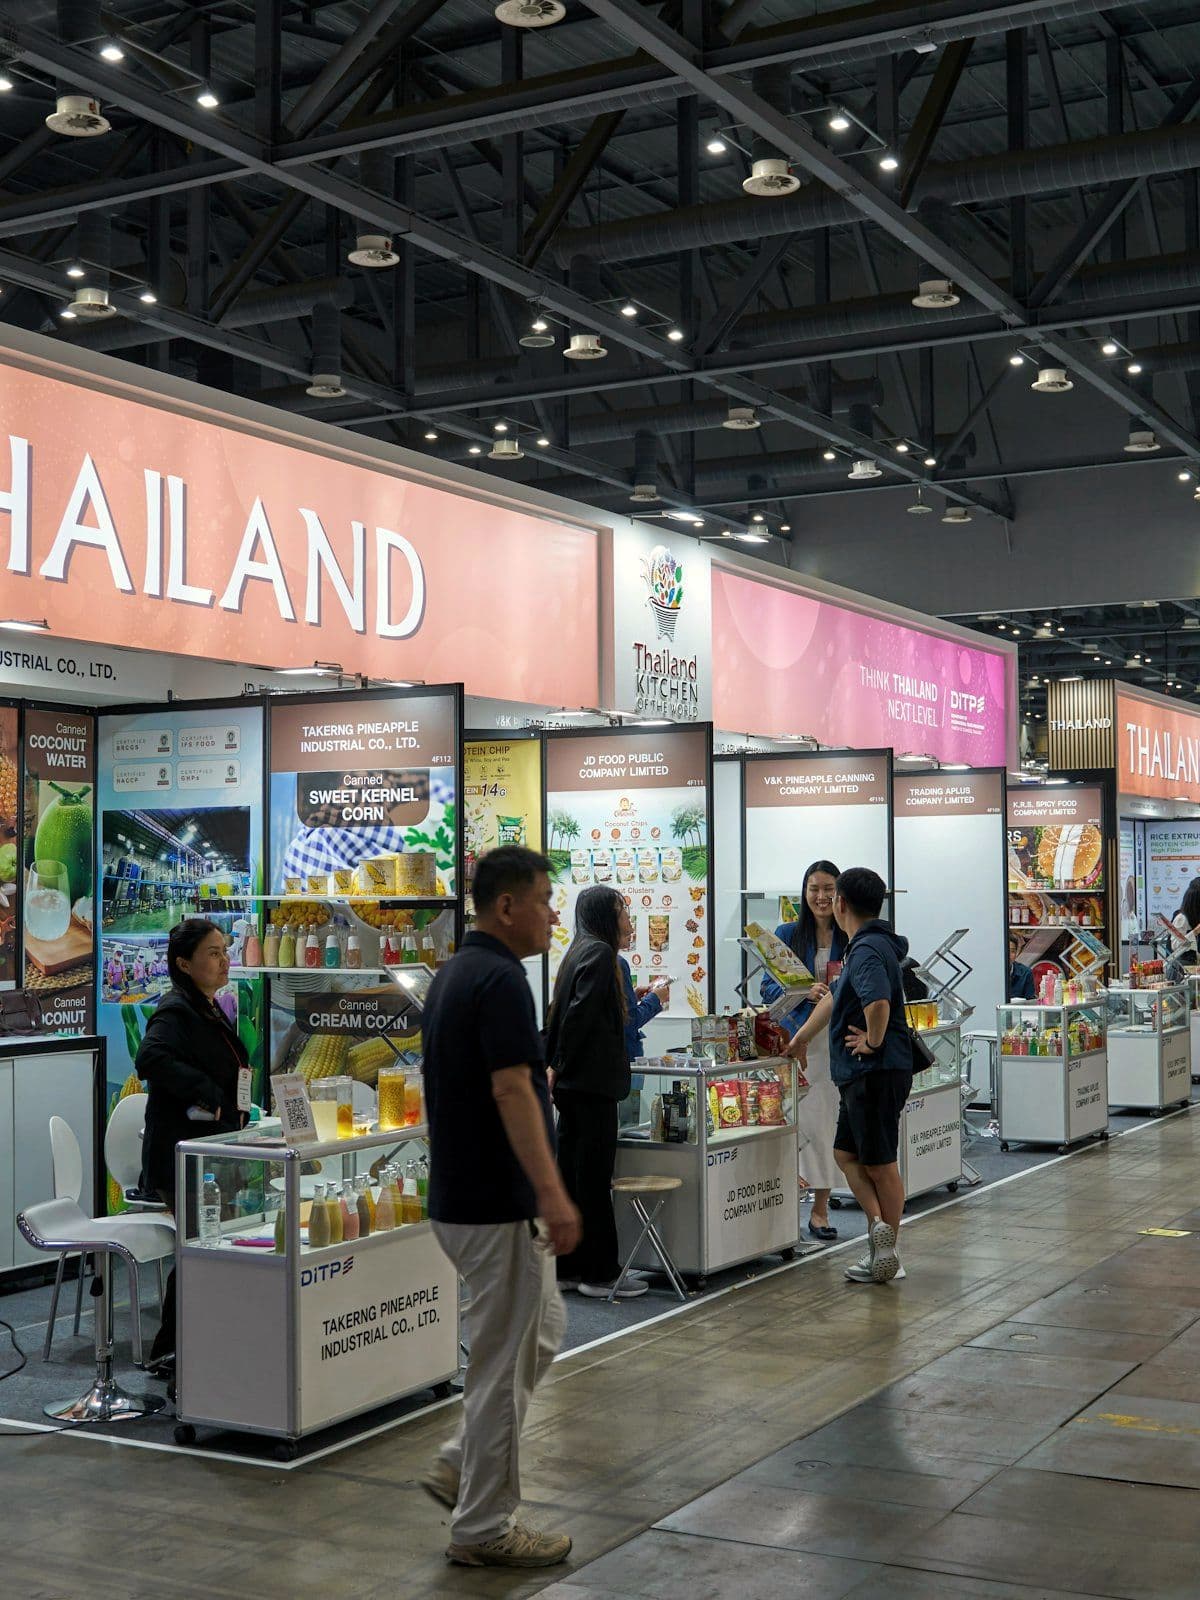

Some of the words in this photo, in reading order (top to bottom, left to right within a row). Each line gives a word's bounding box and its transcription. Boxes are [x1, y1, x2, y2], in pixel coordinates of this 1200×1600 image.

[0, 650, 53, 672] STRIAL
[57, 658, 85, 678] CO.,
[90, 662, 117, 681] LTD.
[634, 643, 697, 680] Thailand
[637, 673, 698, 703] KITCHEN
[859, 665, 890, 691] THINK
[893, 673, 938, 702] THAILAND
[637, 697, 649, 710] OF
[651, 700, 668, 714] THE
[671, 702, 699, 718] WORLD
[888, 699, 912, 721] NEXT
[912, 703, 938, 727] LEVEL
[56, 722, 87, 736] Canned
[302, 726, 354, 737] TAKERNG
[357, 721, 419, 734] PINEAPPLE
[1050, 717, 1112, 731] THAILAND
[29, 734, 87, 752] COCONUT
[301, 739, 365, 752] INDUSTRIAL
[368, 738, 392, 750] CO.,
[396, 737, 420, 749] LTD.
[489, 745, 510, 755] CHIP
[46, 752, 87, 769] WATER
[431, 755, 451, 763] 4F112
[583, 756, 596, 766] JD
[598, 754, 626, 765] FOOD
[628, 752, 664, 764] PUBLIC
[343, 774, 383, 785] Canned
[579, 767, 627, 779] COMPANY
[629, 765, 669, 777] LIMITED
[764, 776, 783, 785] V&K
[785, 774, 833, 784] PINEAPPLE
[834, 773, 875, 782] CANNING
[309, 789, 358, 804] SWEET
[361, 787, 419, 803] KERNEL
[779, 786, 822, 795] COMPANY
[824, 784, 859, 794] LIMITED
[909, 787, 944, 796] TRADING
[945, 786, 971, 795] APLUS
[905, 797, 943, 806] COMPANY
[944, 796, 975, 804] LIMITED
[341, 807, 384, 821] CORN
[1171, 832, 1200, 840] EXTRU
[54, 996, 86, 1008] Canned
[339, 999, 379, 1011] Canned
[309, 1012, 362, 1029] CREAM
[915, 1142, 936, 1157] COMPANY
[936, 1136, 952, 1150] LIMITED
[726, 1190, 736, 1203] JD
[737, 1184, 756, 1200] FOOD
[757, 1177, 781, 1195] PUBLIC
[724, 1201, 757, 1221] COMPANY
[758, 1193, 784, 1211] LIMITED
[322, 1305, 377, 1336] TAKERNG
[380, 1285, 439, 1318] PINEAPPLE
[321, 1325, 388, 1361] INDUSTRIAL
[391, 1318, 414, 1337] CO.,
[417, 1309, 440, 1328] LTD.
